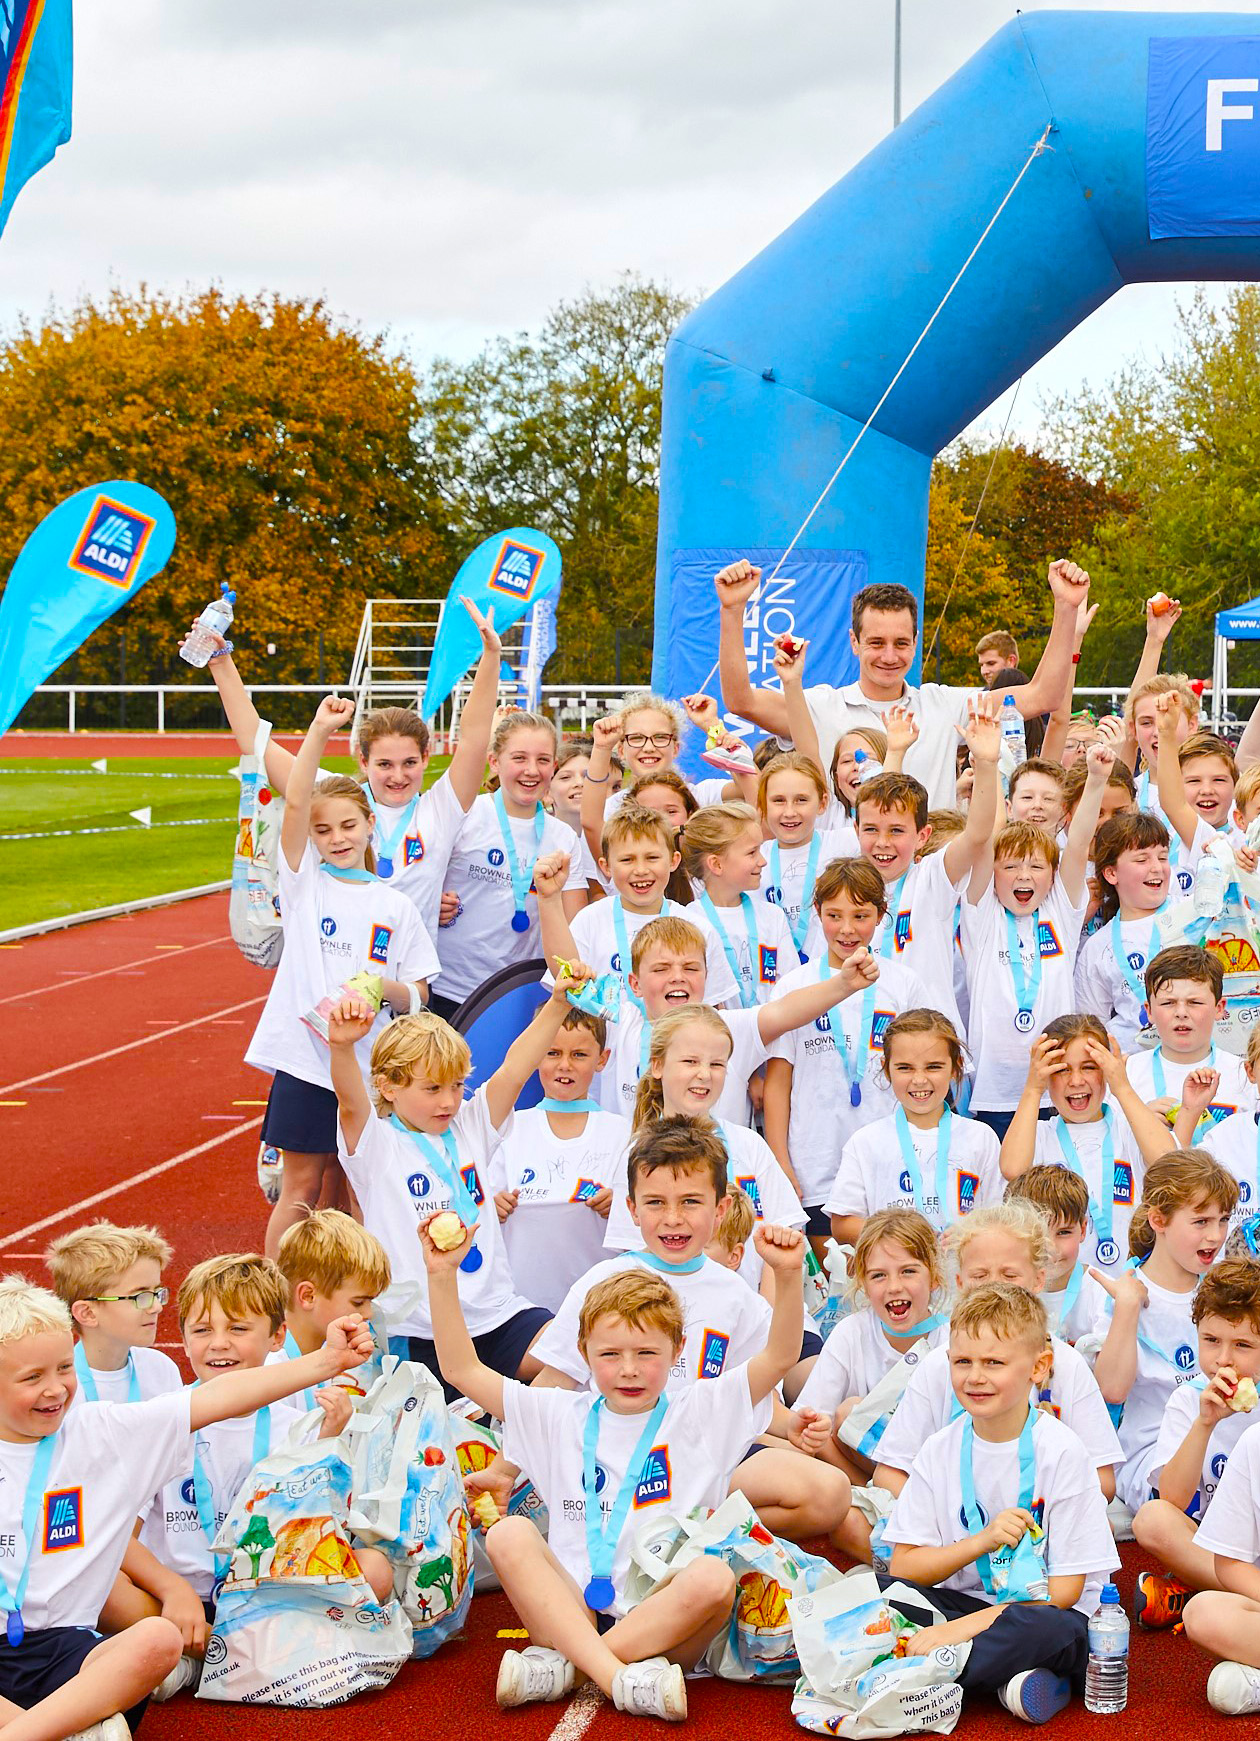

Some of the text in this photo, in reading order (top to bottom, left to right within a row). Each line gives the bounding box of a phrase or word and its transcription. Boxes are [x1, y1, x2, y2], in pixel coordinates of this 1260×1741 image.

[84, 544, 128, 572] ALDI
[497, 571, 528, 589] ALDI
[639, 1479, 668, 1497] ALDI
[50, 1525, 76, 1541] ALDI
[203, 1661, 241, 1684] aldi.co.uk
[241, 1685, 270, 1703] Please
[270, 1672, 298, 1693] reuse
[299, 1664, 318, 1677] this
[318, 1656, 339, 1671] bag
[275, 1691, 283, 1703] it
[283, 1688, 292, 1699] is
[292, 1678, 319, 1695] worn
[320, 1670, 337, 1683] out
[338, 1664, 354, 1676] we
[354, 1658, 370, 1670] will
[308, 1692, 318, 1702] is
[318, 1681, 346, 1698] made
[903, 1703, 930, 1717] when
[931, 1699, 938, 1709] it
[938, 1695, 944, 1705] is
[943, 1685, 961, 1700] worn
[921, 1701, 961, 1725] This bag is
